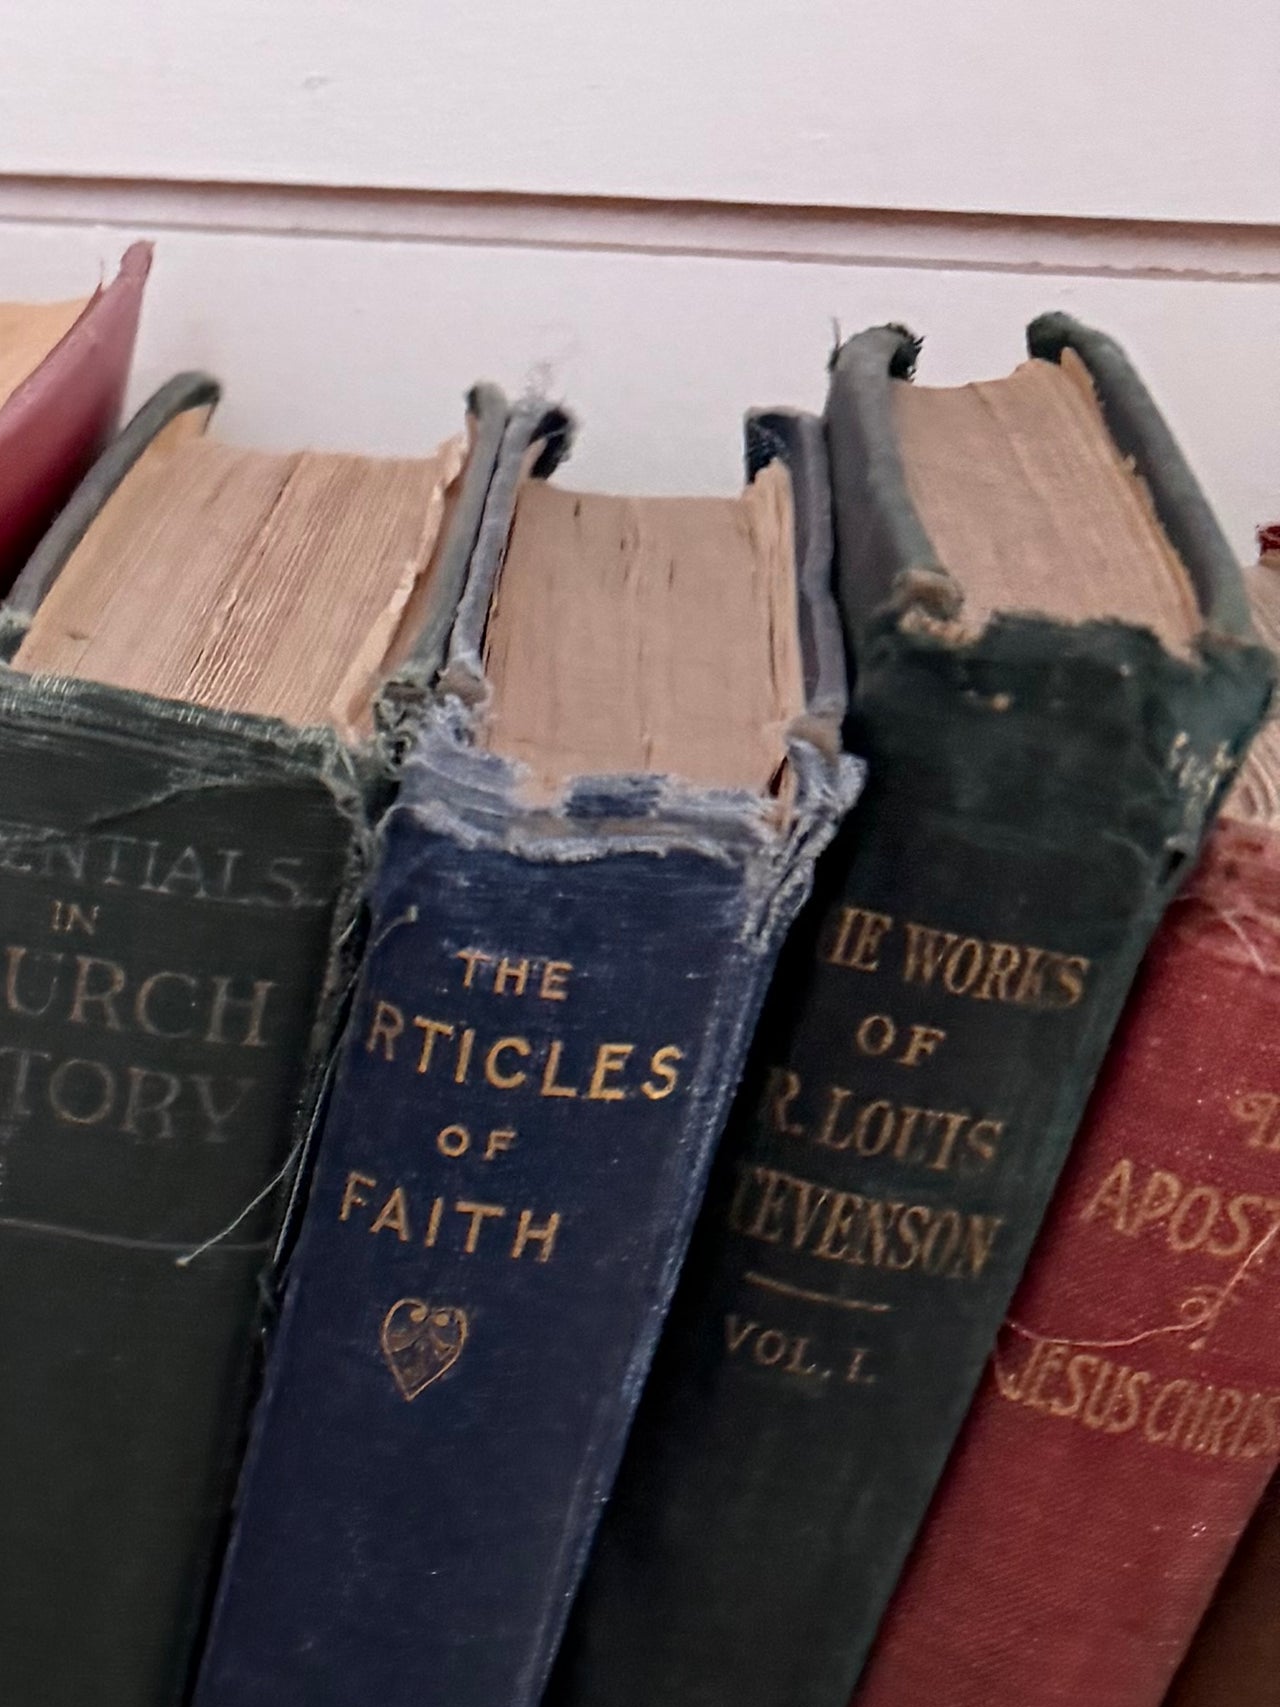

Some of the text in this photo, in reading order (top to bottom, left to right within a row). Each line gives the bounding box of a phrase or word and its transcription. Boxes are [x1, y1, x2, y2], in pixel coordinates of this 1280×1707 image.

[51, 899, 100, 936] IN
[454, 948, 574, 1001] THE
[902, 922, 1092, 1009] WORKS
[365, 1000, 685, 1101] RTICLES
[855, 1013, 947, 1067] OF
[436, 1122, 519, 1162] OF
[817, 1086, 1007, 1172] LOUIS
[338, 1170, 561, 1264] FAITH
[724, 1314, 832, 1379] VOL.
[994, 1339, 1151, 1434] JESUS
